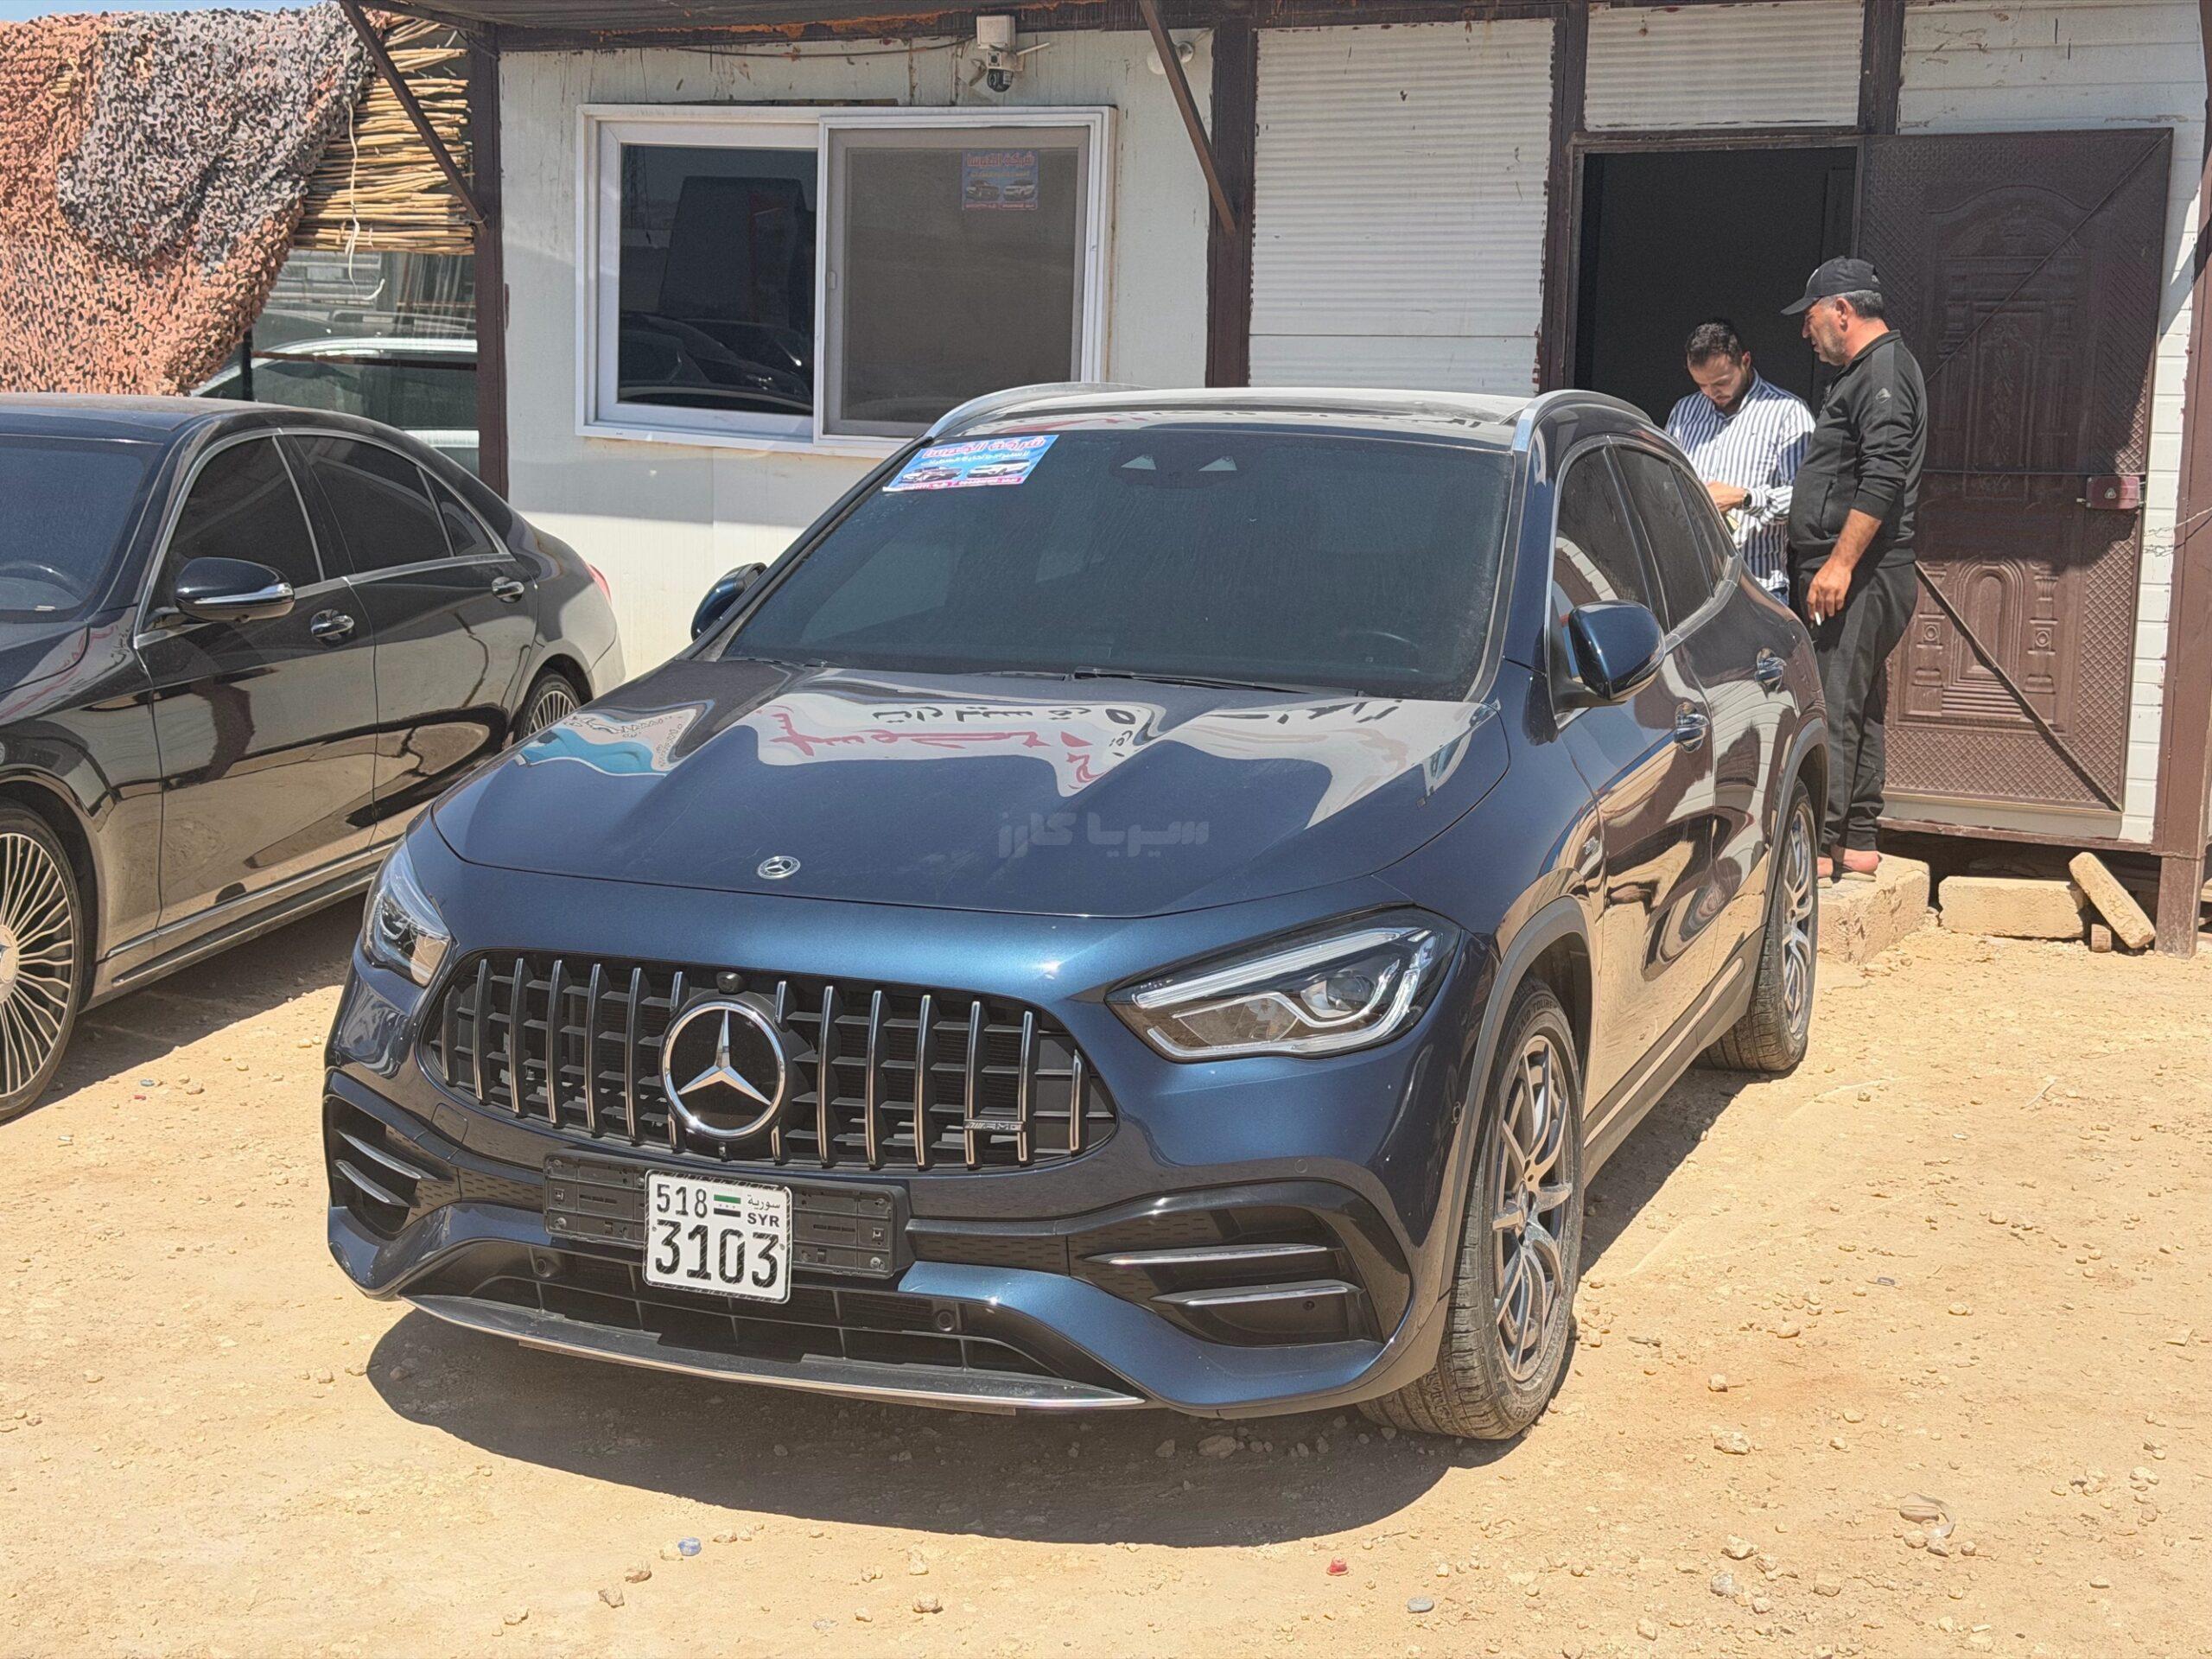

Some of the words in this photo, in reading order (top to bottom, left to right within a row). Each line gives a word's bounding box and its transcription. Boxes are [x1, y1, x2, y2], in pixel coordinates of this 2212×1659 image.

[657, 1183, 708, 1218] 518
[747, 1194, 781, 1211] سورية
[747, 1212, 780, 1228] SYR
[655, 1218, 779, 1288] 3103
